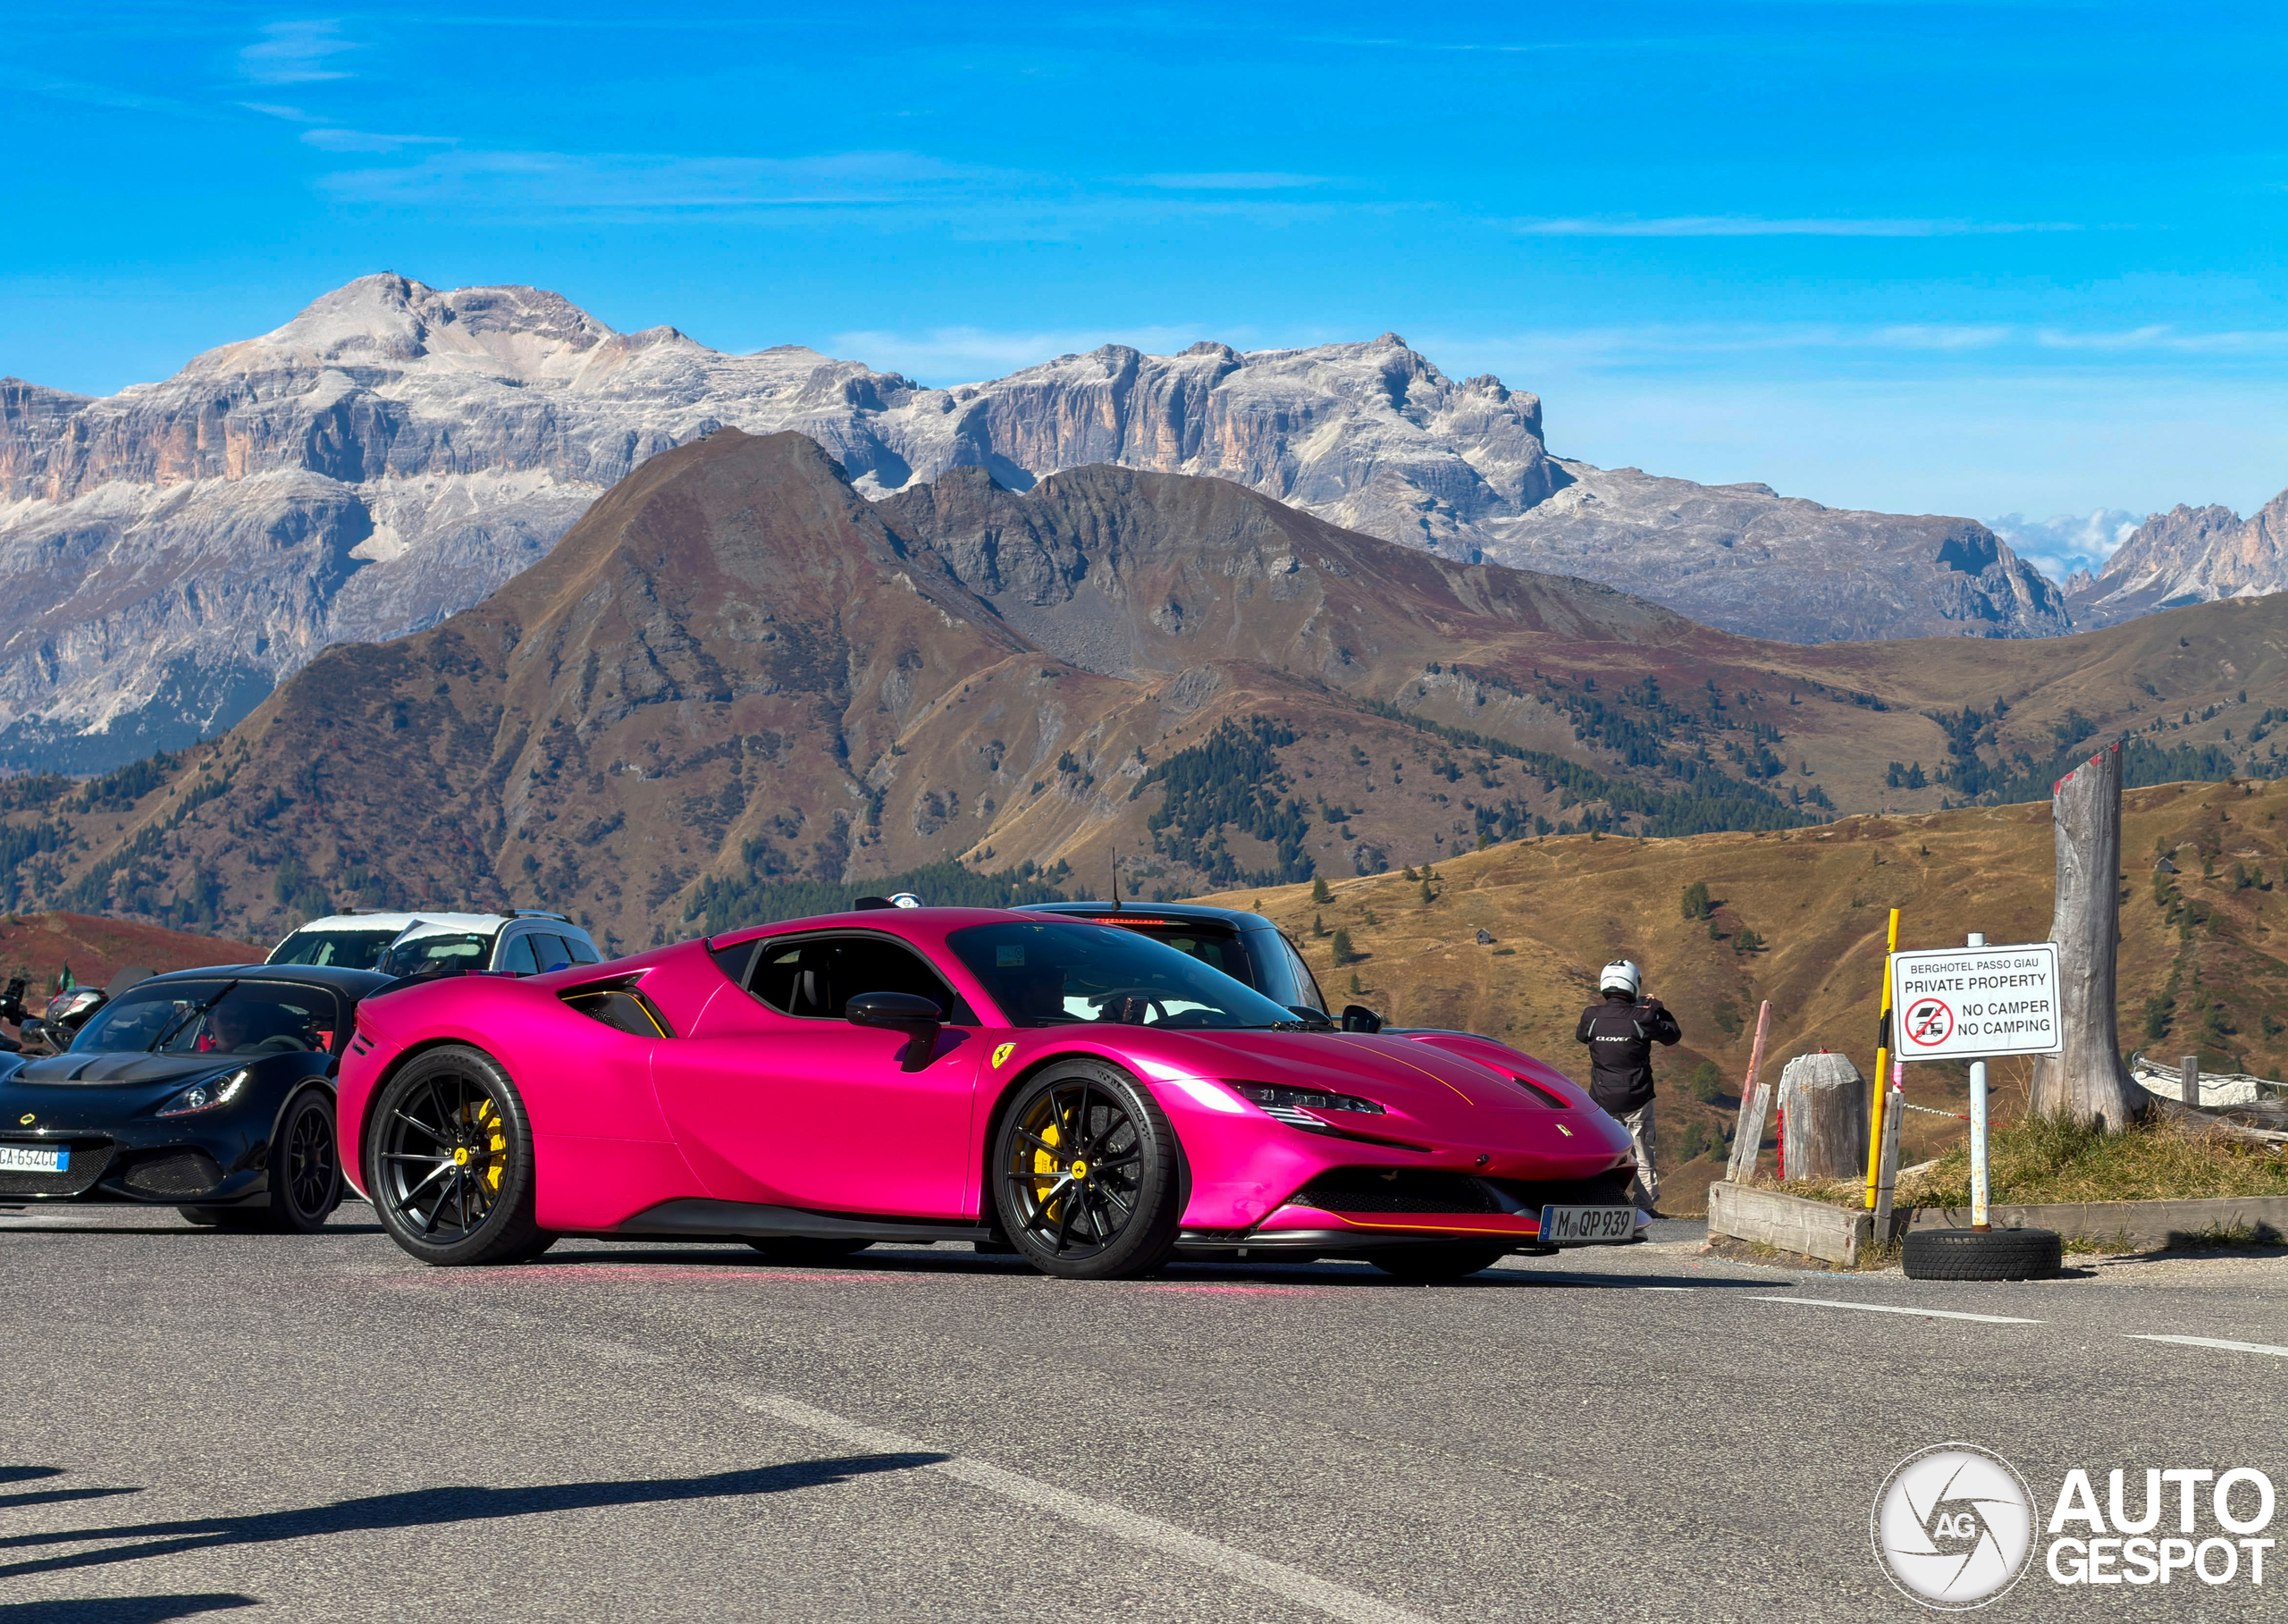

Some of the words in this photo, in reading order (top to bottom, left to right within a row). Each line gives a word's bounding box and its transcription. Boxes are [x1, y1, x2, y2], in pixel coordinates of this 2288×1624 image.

[1911, 962, 1974, 974] BERGHOTEL
[1977, 960, 2011, 971] PASSO
[2014, 958, 2039, 968] GIAU
[1905, 978, 1964, 993] PRIVATE
[1969, 973, 2047, 989] PROPERTY
[1963, 1004, 1983, 1017] NO
[1988, 1000, 2049, 1015] CAMPER
[1958, 1023, 1979, 1036] NO
[1983, 1019, 2050, 1034] CAMPING
[1118, 1085, 1144, 1122] MICHELIN
[1556, 1210, 1571, 1236] M
[1578, 1210, 1601, 1236] QP
[1602, 1210, 1630, 1236] 939
